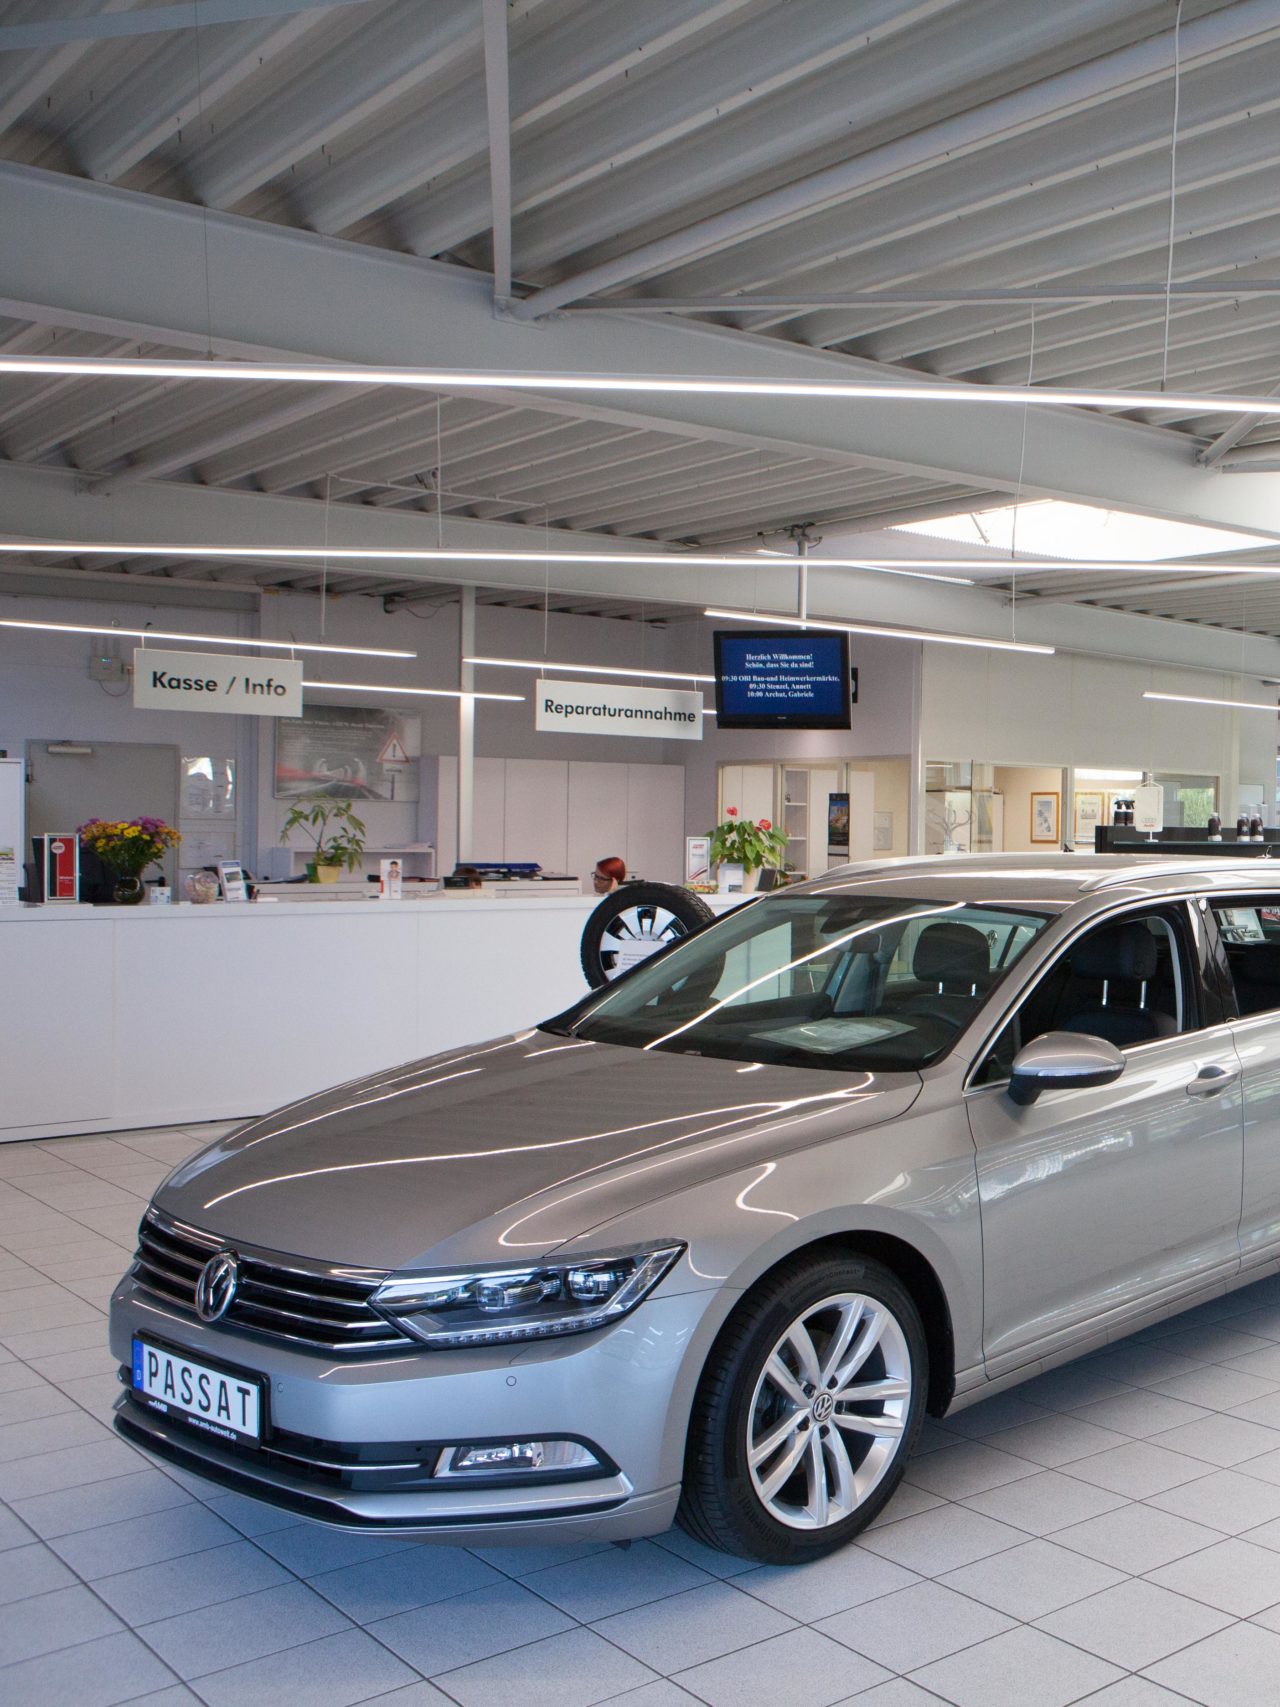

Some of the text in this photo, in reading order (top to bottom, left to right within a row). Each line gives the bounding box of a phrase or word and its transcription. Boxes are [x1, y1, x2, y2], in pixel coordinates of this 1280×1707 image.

[152, 670, 287, 696] Kasse / Info
[544, 698, 696, 723] Reparaturannahme
[148, 1350, 251, 1427] PASSAT
